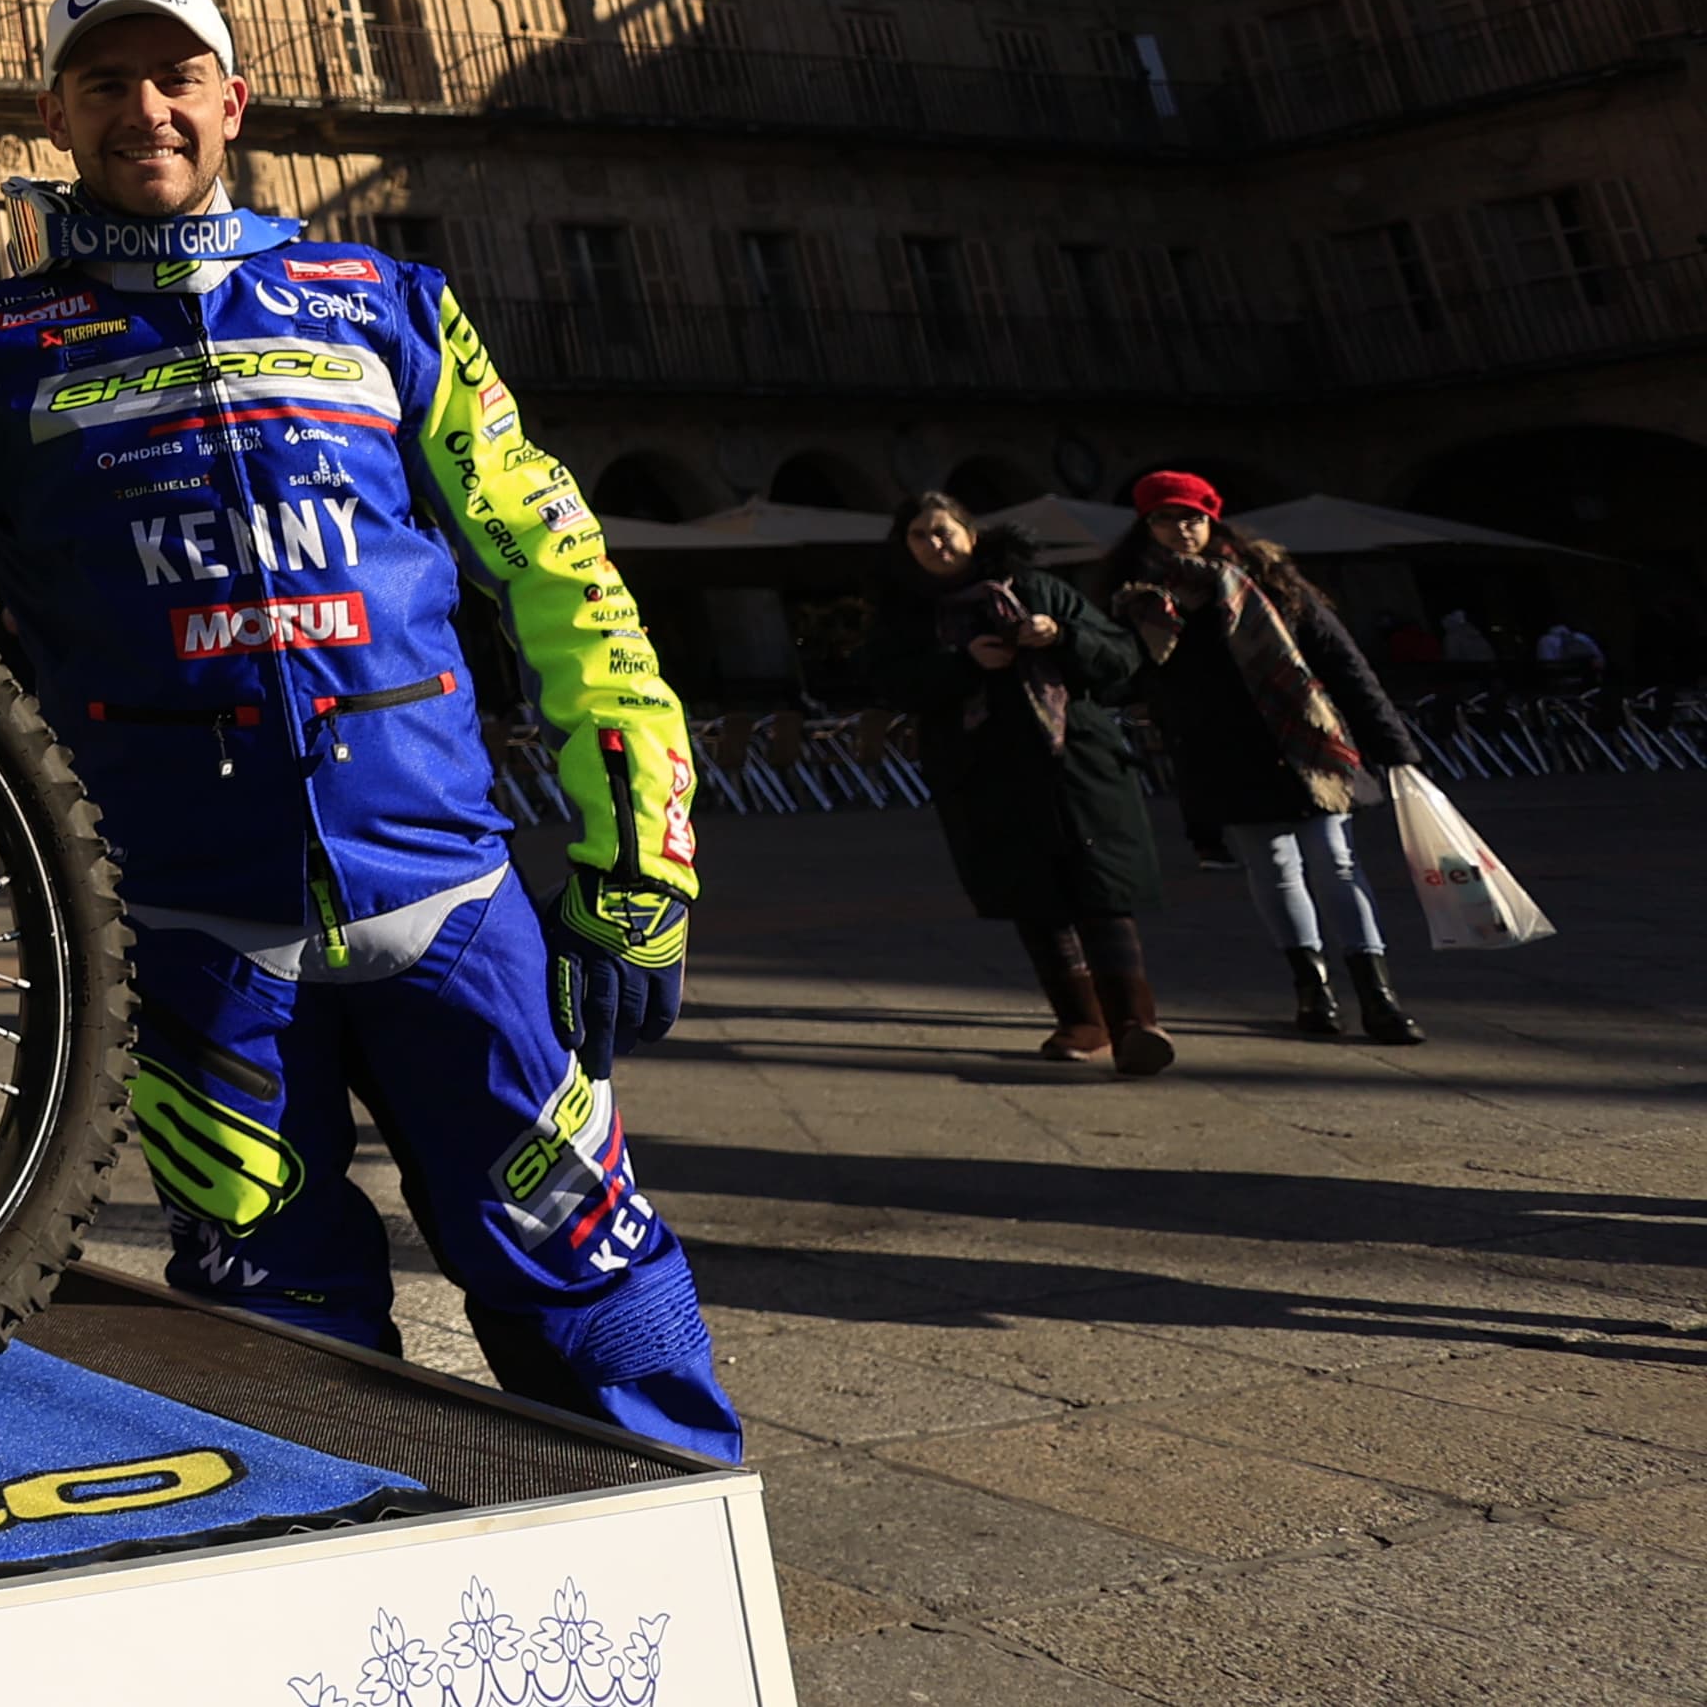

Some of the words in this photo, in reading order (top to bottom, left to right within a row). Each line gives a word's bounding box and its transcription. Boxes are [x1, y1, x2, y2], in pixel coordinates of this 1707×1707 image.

[105, 223, 174, 256] PONT
[179, 217, 242, 254] GRUP
[1, 296, 92, 327] MOTUL
[308, 301, 378, 325] GRUP
[49, 350, 364, 414] SHERCO
[118, 441, 184, 465] ANDRÉS
[455, 459, 494, 516] PONT
[484, 517, 529, 569] GRUP
[131, 497, 359, 586] KENNY
[184, 599, 359, 653] MOTUL
[504, 1062, 594, 1201] SHE
